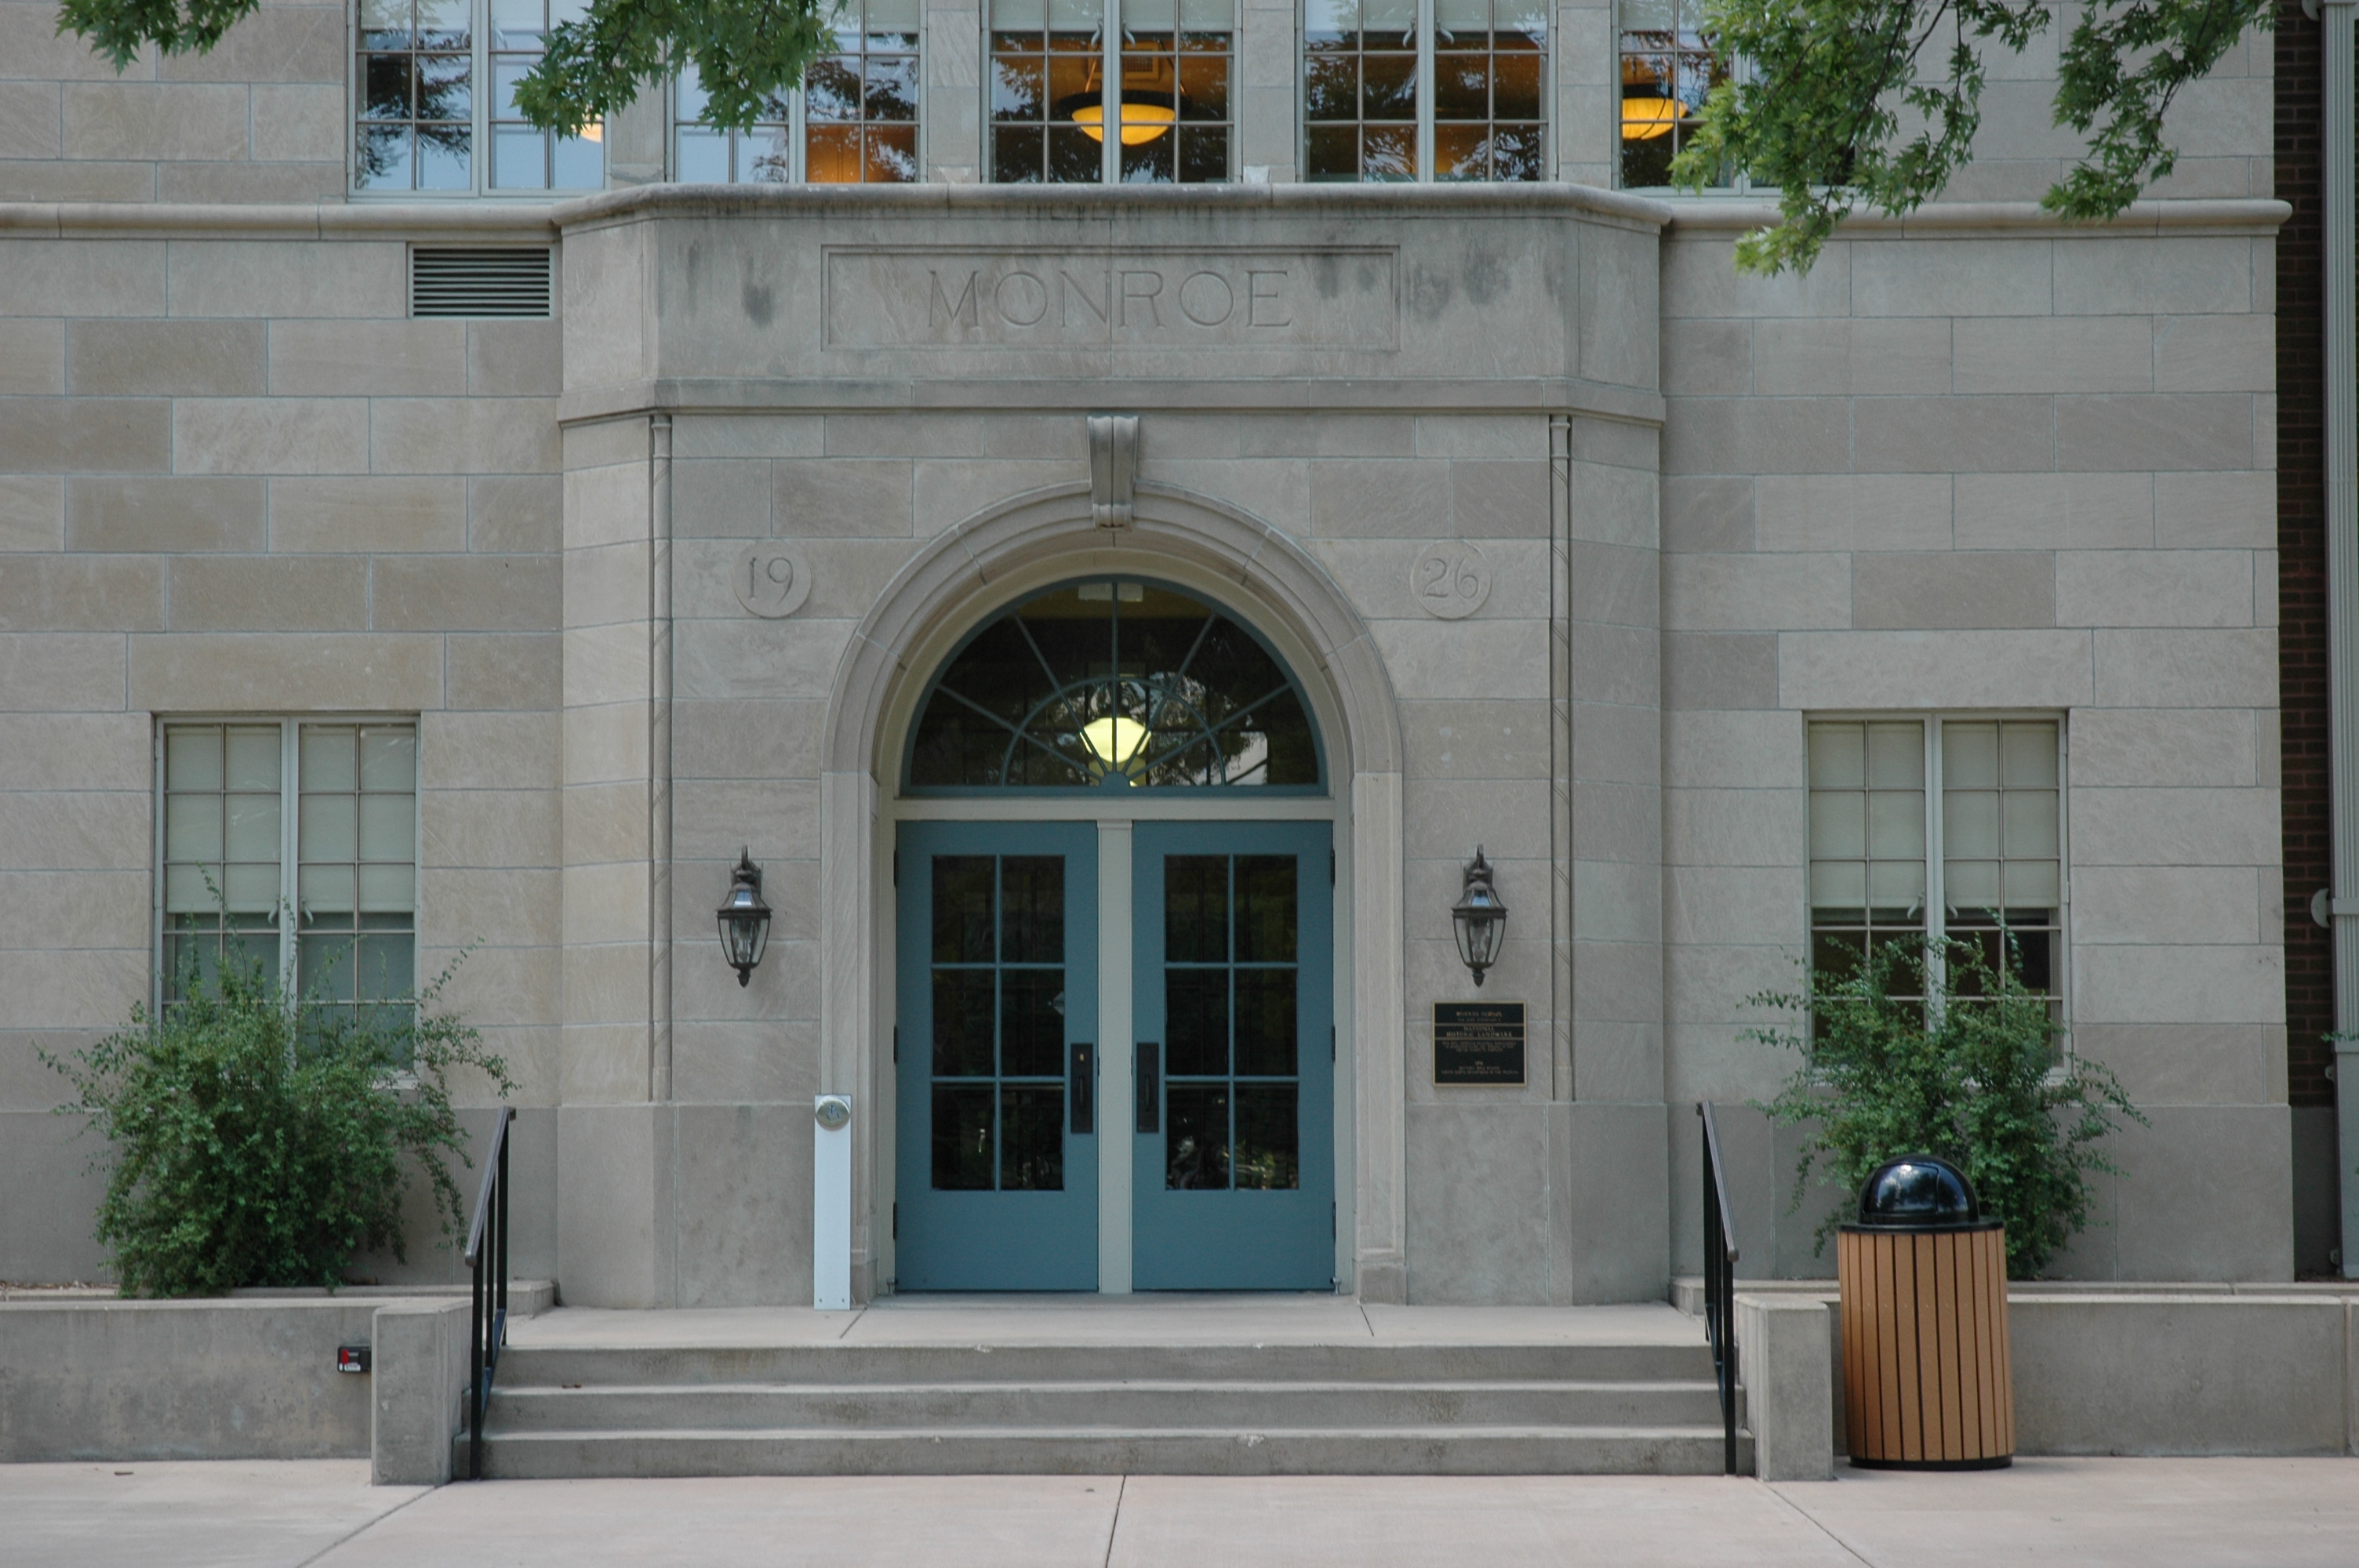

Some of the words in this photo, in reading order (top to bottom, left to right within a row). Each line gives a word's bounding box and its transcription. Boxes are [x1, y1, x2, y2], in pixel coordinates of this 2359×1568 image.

[927, 269, 1292, 328] MONROE
[749, 557, 794, 605] 19
[1423, 557, 1479, 599] 26
